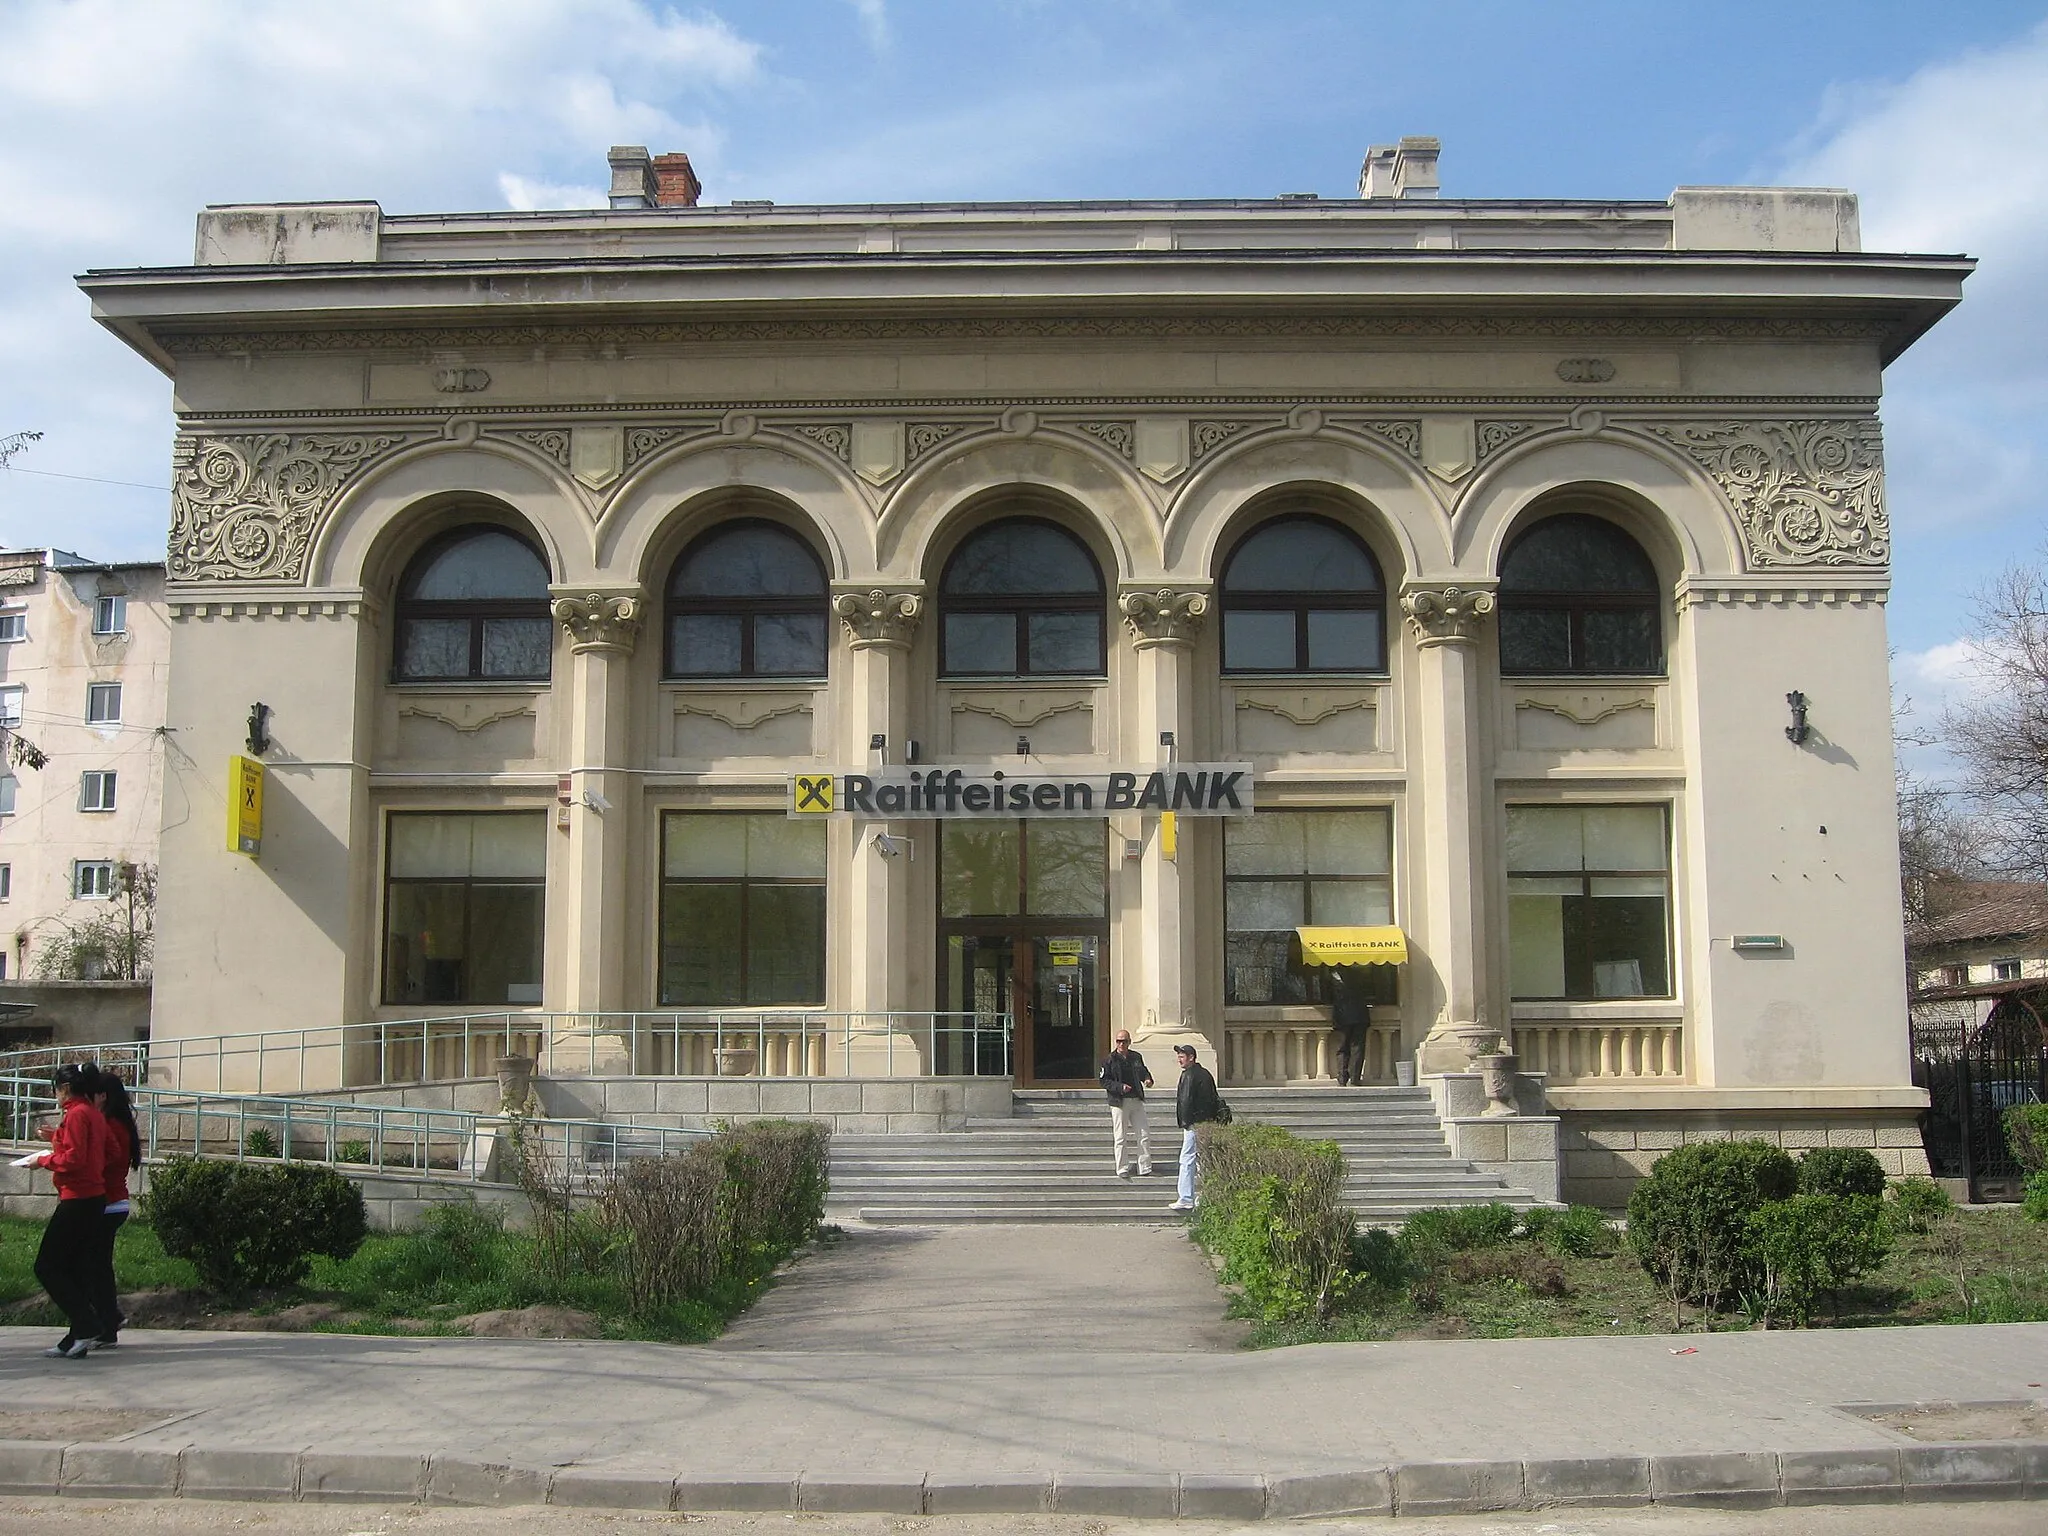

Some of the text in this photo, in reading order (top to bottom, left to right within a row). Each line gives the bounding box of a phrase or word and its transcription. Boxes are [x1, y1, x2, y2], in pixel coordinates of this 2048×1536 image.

[844, 769, 1245, 813] Raiffeisen BANK
[1319, 941, 1368, 949] Raiffeisen
